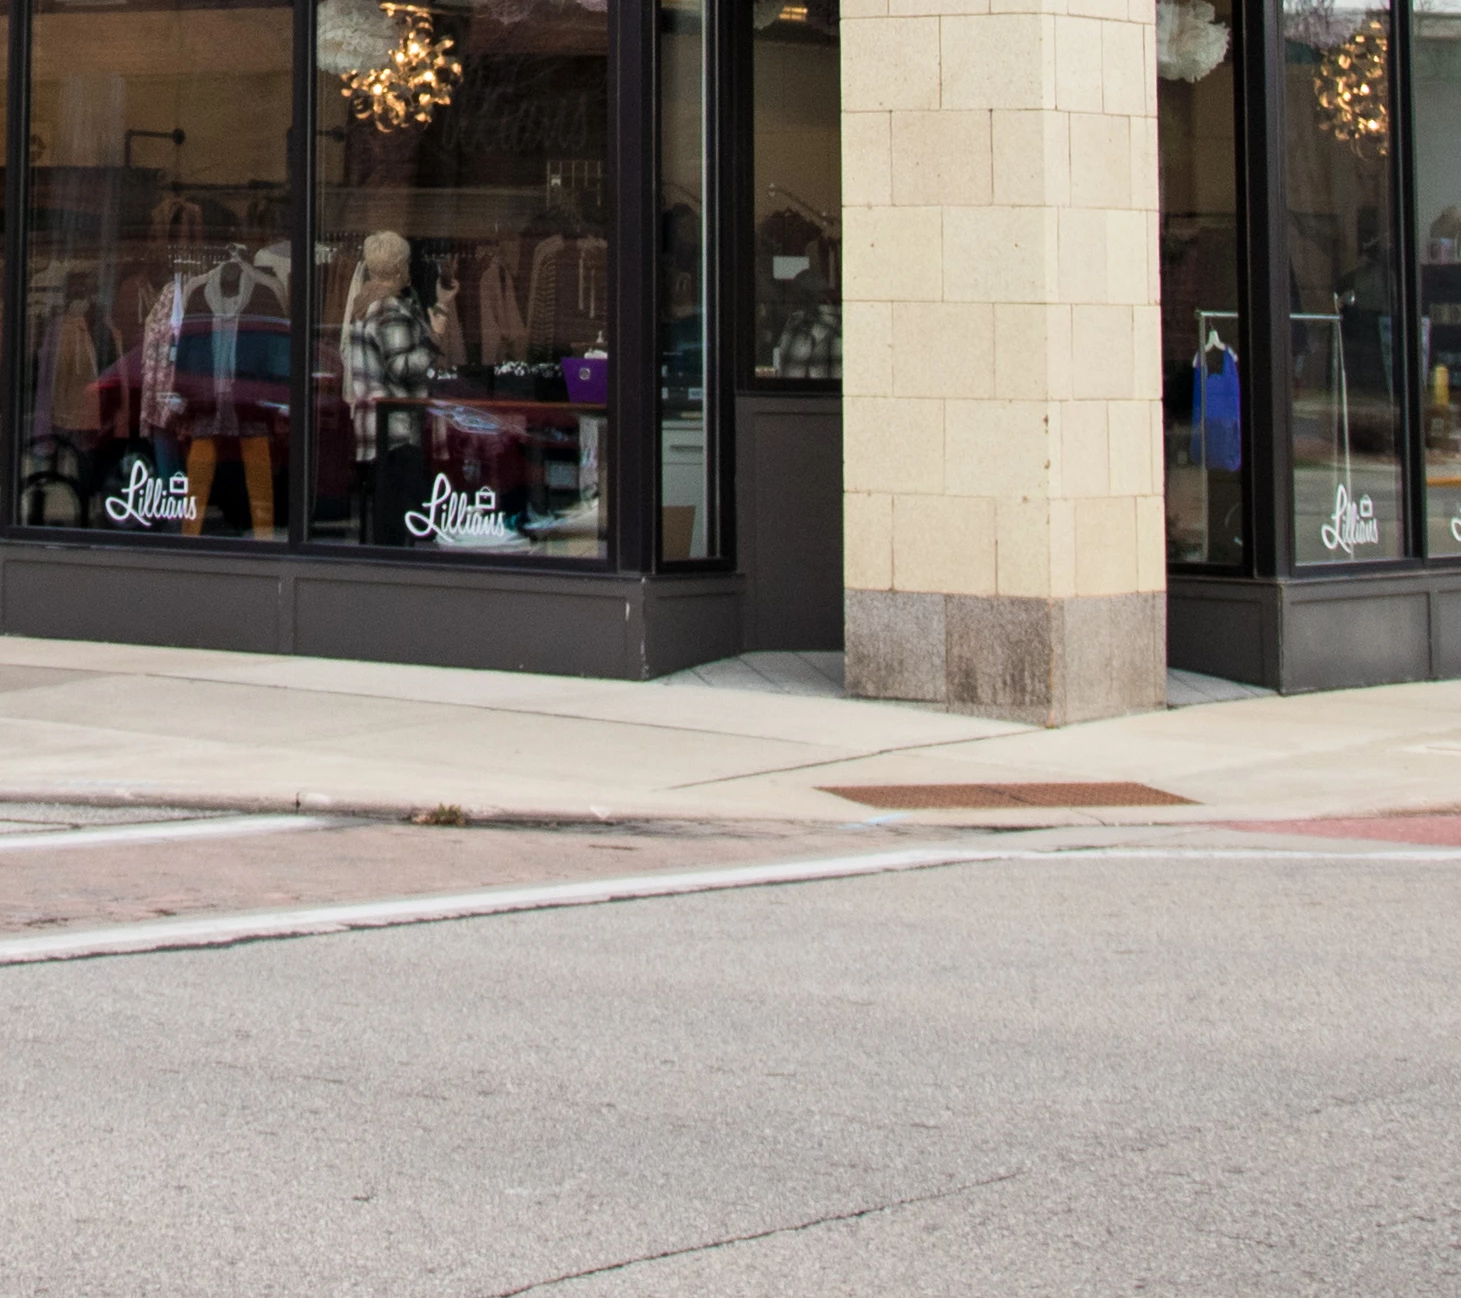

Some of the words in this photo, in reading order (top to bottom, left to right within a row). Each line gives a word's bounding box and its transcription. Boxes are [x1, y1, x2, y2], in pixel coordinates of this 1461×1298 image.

[105, 459, 198, 527] Lillians
[404, 472, 506, 543] Lillians
[1321, 483, 1379, 554] Lillians
